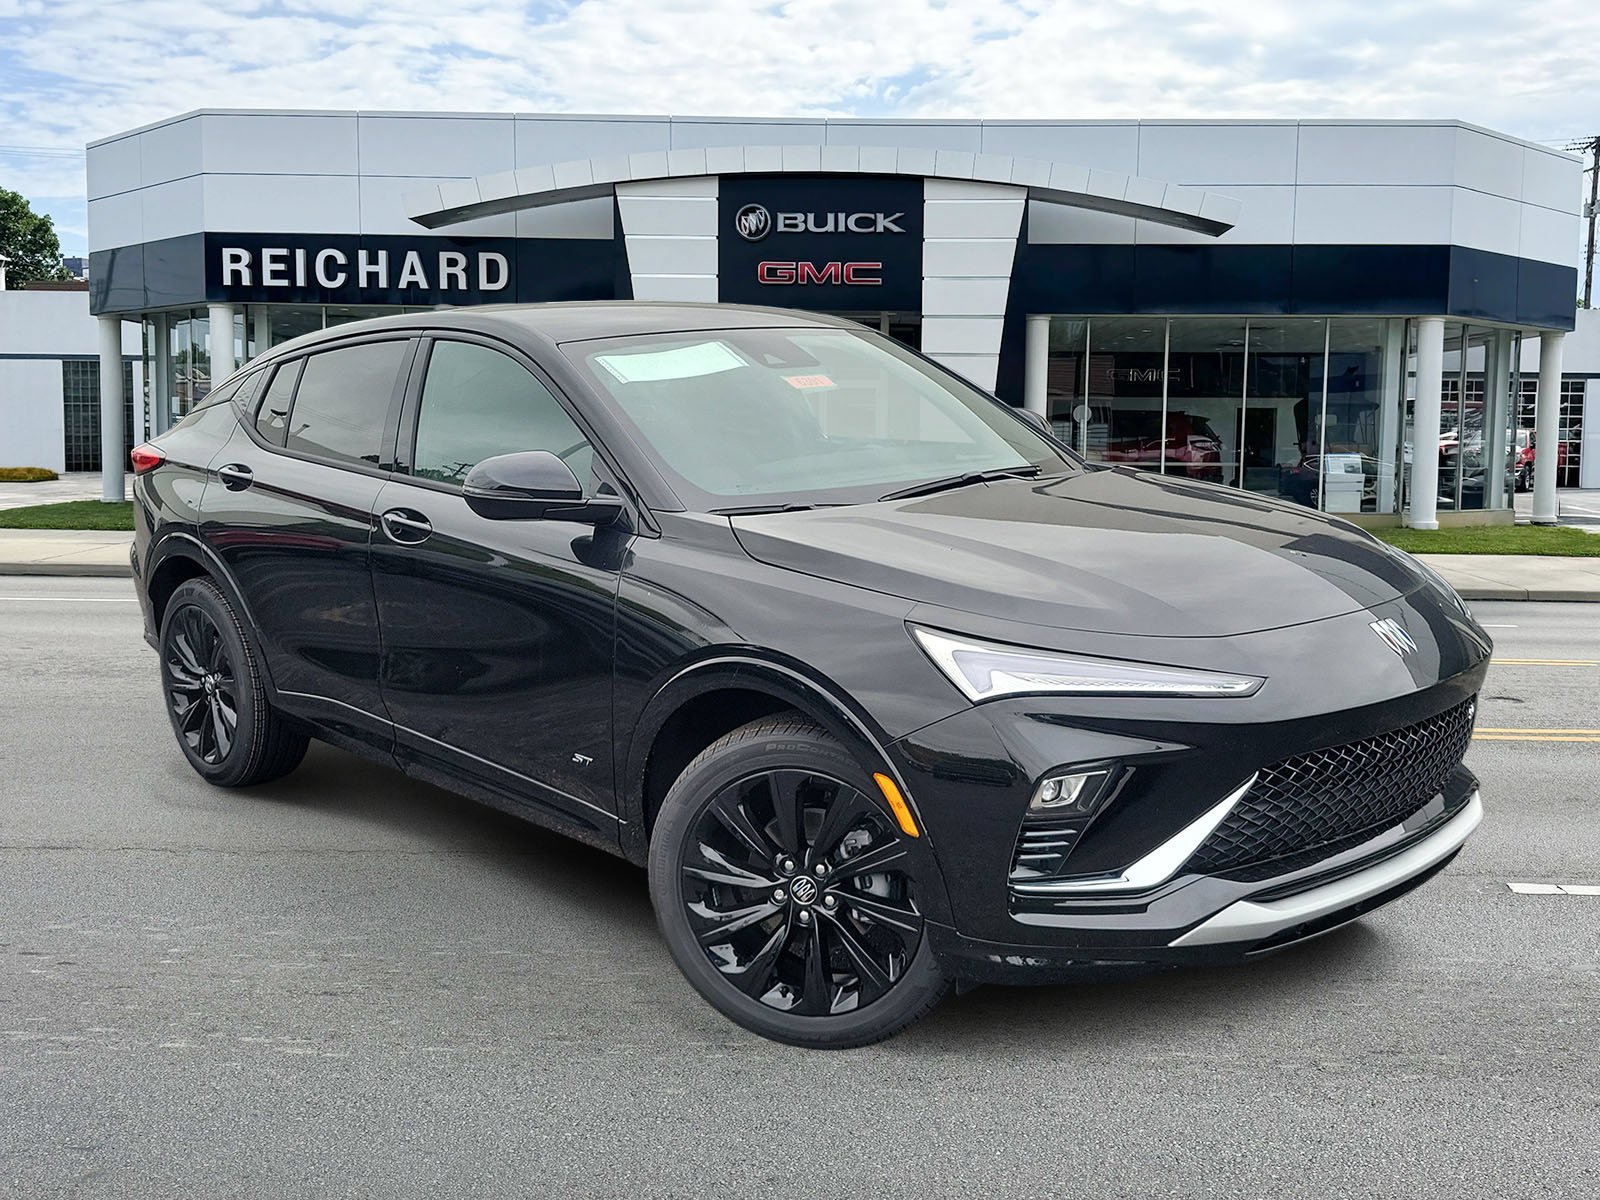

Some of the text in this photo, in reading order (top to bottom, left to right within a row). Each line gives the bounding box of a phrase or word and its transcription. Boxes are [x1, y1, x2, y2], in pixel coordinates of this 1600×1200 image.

[777, 212, 906, 233] BUICK
[221, 247, 509, 291] REICHARD
[757, 261, 882, 285] GMC
[1106, 368, 1180, 382] GMC
[572, 753, 593, 766] ST
